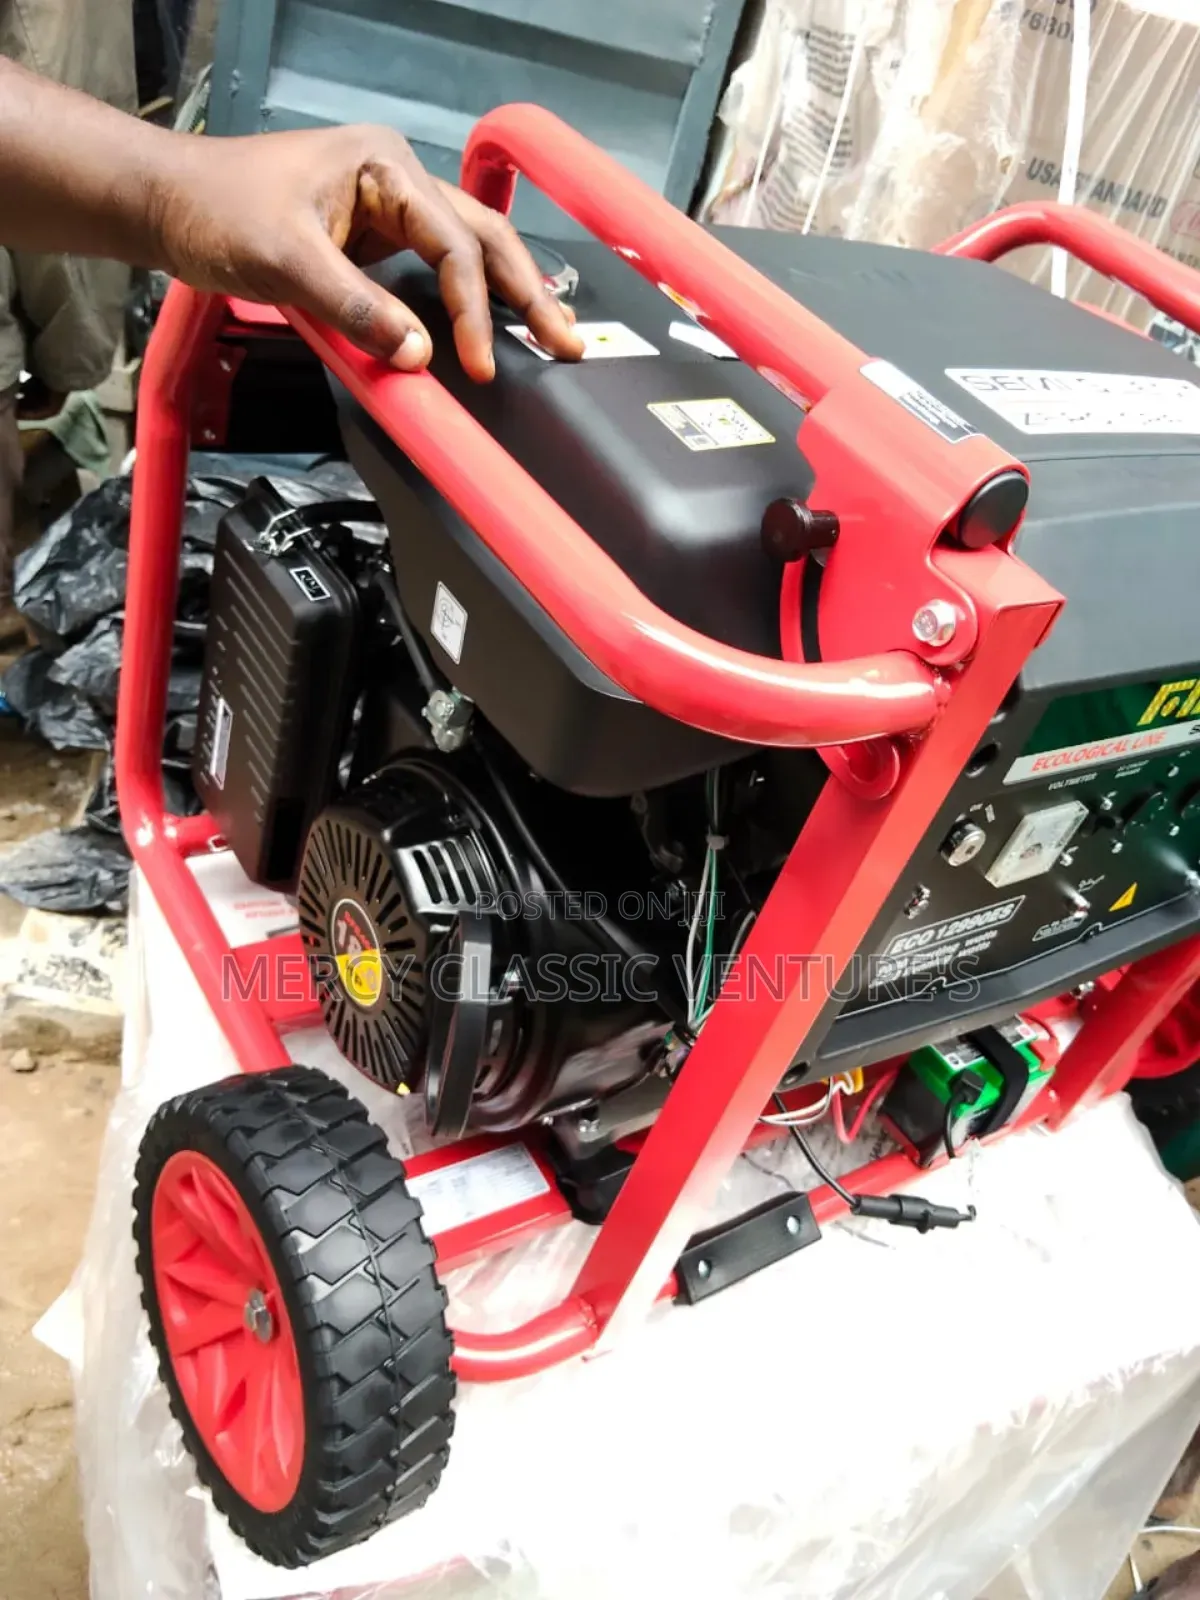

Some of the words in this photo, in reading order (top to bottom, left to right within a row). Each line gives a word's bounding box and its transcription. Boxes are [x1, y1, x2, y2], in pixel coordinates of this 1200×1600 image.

[1031, 738, 1130, 772] ECOLOGICAL
[1132, 731, 1168, 750] LINE
[890, 928, 935, 955] ECO
